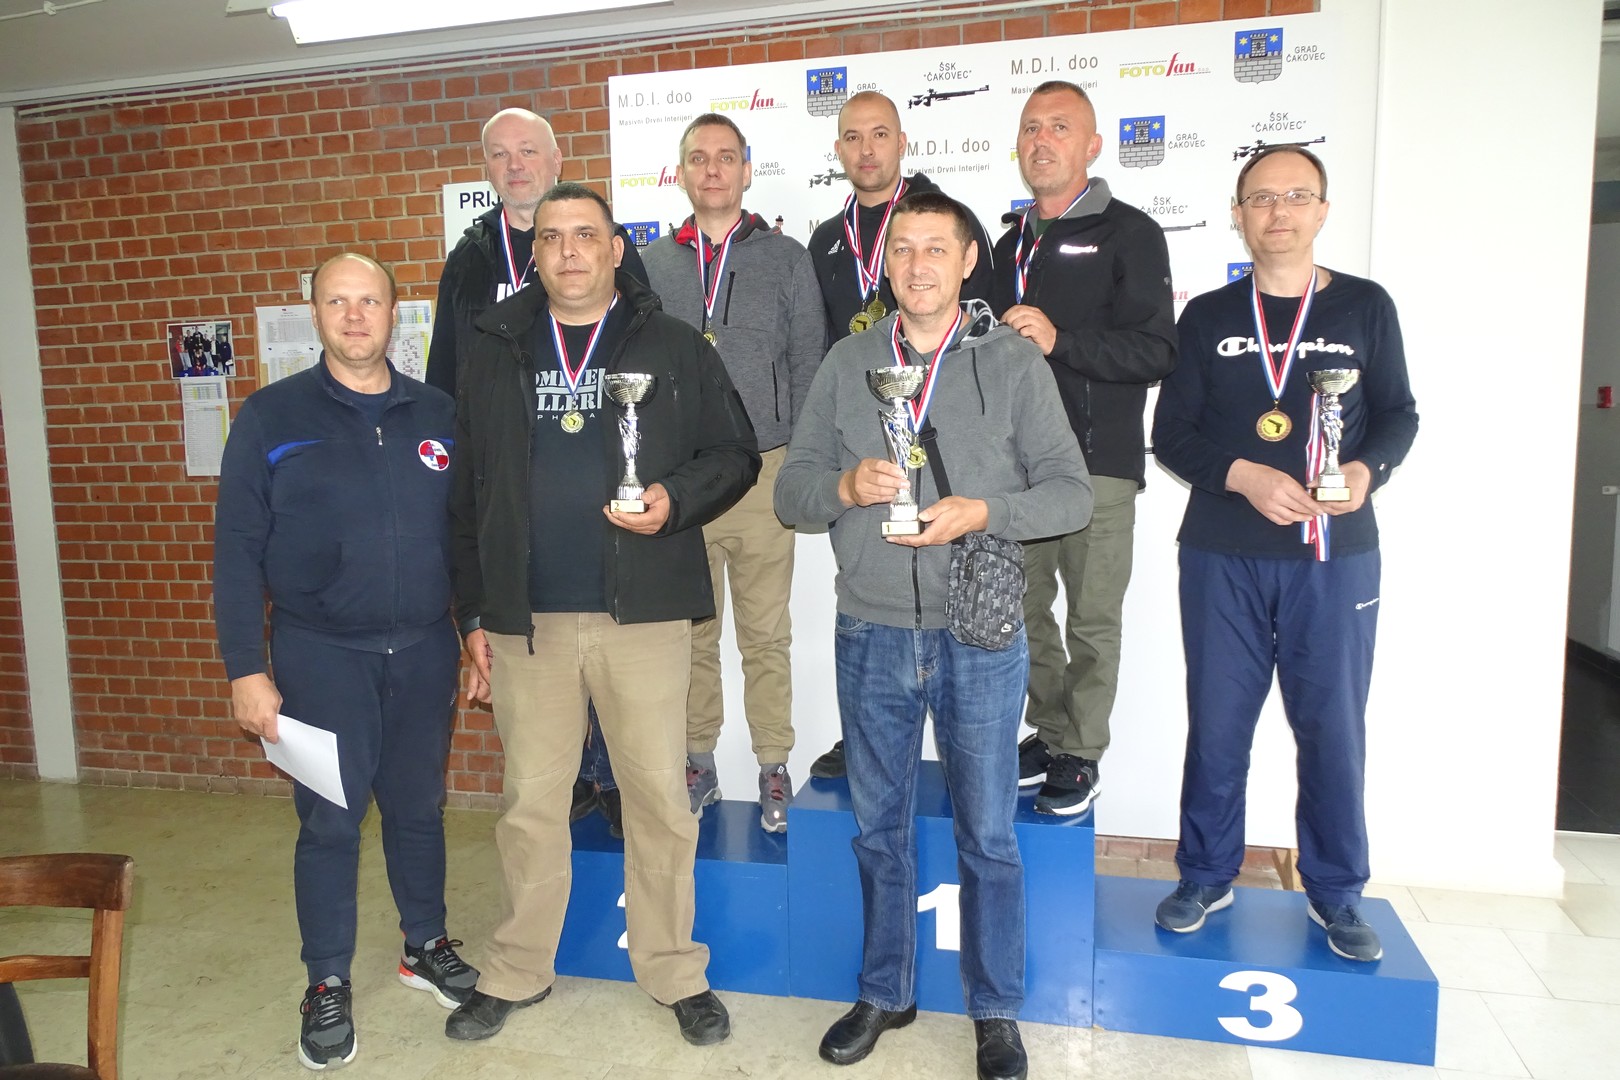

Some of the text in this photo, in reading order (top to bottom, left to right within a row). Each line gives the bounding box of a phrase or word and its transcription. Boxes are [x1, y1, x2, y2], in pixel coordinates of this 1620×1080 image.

[1294, 45, 1318, 54] GRAD
[1286, 52, 1326, 62] ČAKOVEC
[939, 62, 956, 71] ŠSK
[1011, 54, 1098, 75] M.D.I. doo
[857, 82, 877, 91] GRAD
[1011, 86, 1036, 94] Masiv
[618, 90, 692, 108] M.D.I. doo
[619, 114, 693, 126] Masivni Drvni Interijeri
[1269, 112, 1289, 122] ŠSK
[1176, 133, 1198, 141] GRAD
[907, 138, 990, 157] M.D.I. doo
[1168, 140, 1206, 150] ČAKOVEC
[760, 162, 779, 170] GRAD
[937, 165, 956, 174] Drvni
[958, 162, 990, 173] Interijeri
[754, 168, 786, 177] ČAKOVEC
[460, 190, 501, 209] PRIJ
[1153, 196, 1171, 206] ŠSK
[1217, 336, 1355, 359] Chmpion
[536, 393, 597, 411] LLER
[917, 883, 961, 951] 1
[1217, 970, 1303, 1041] 3
